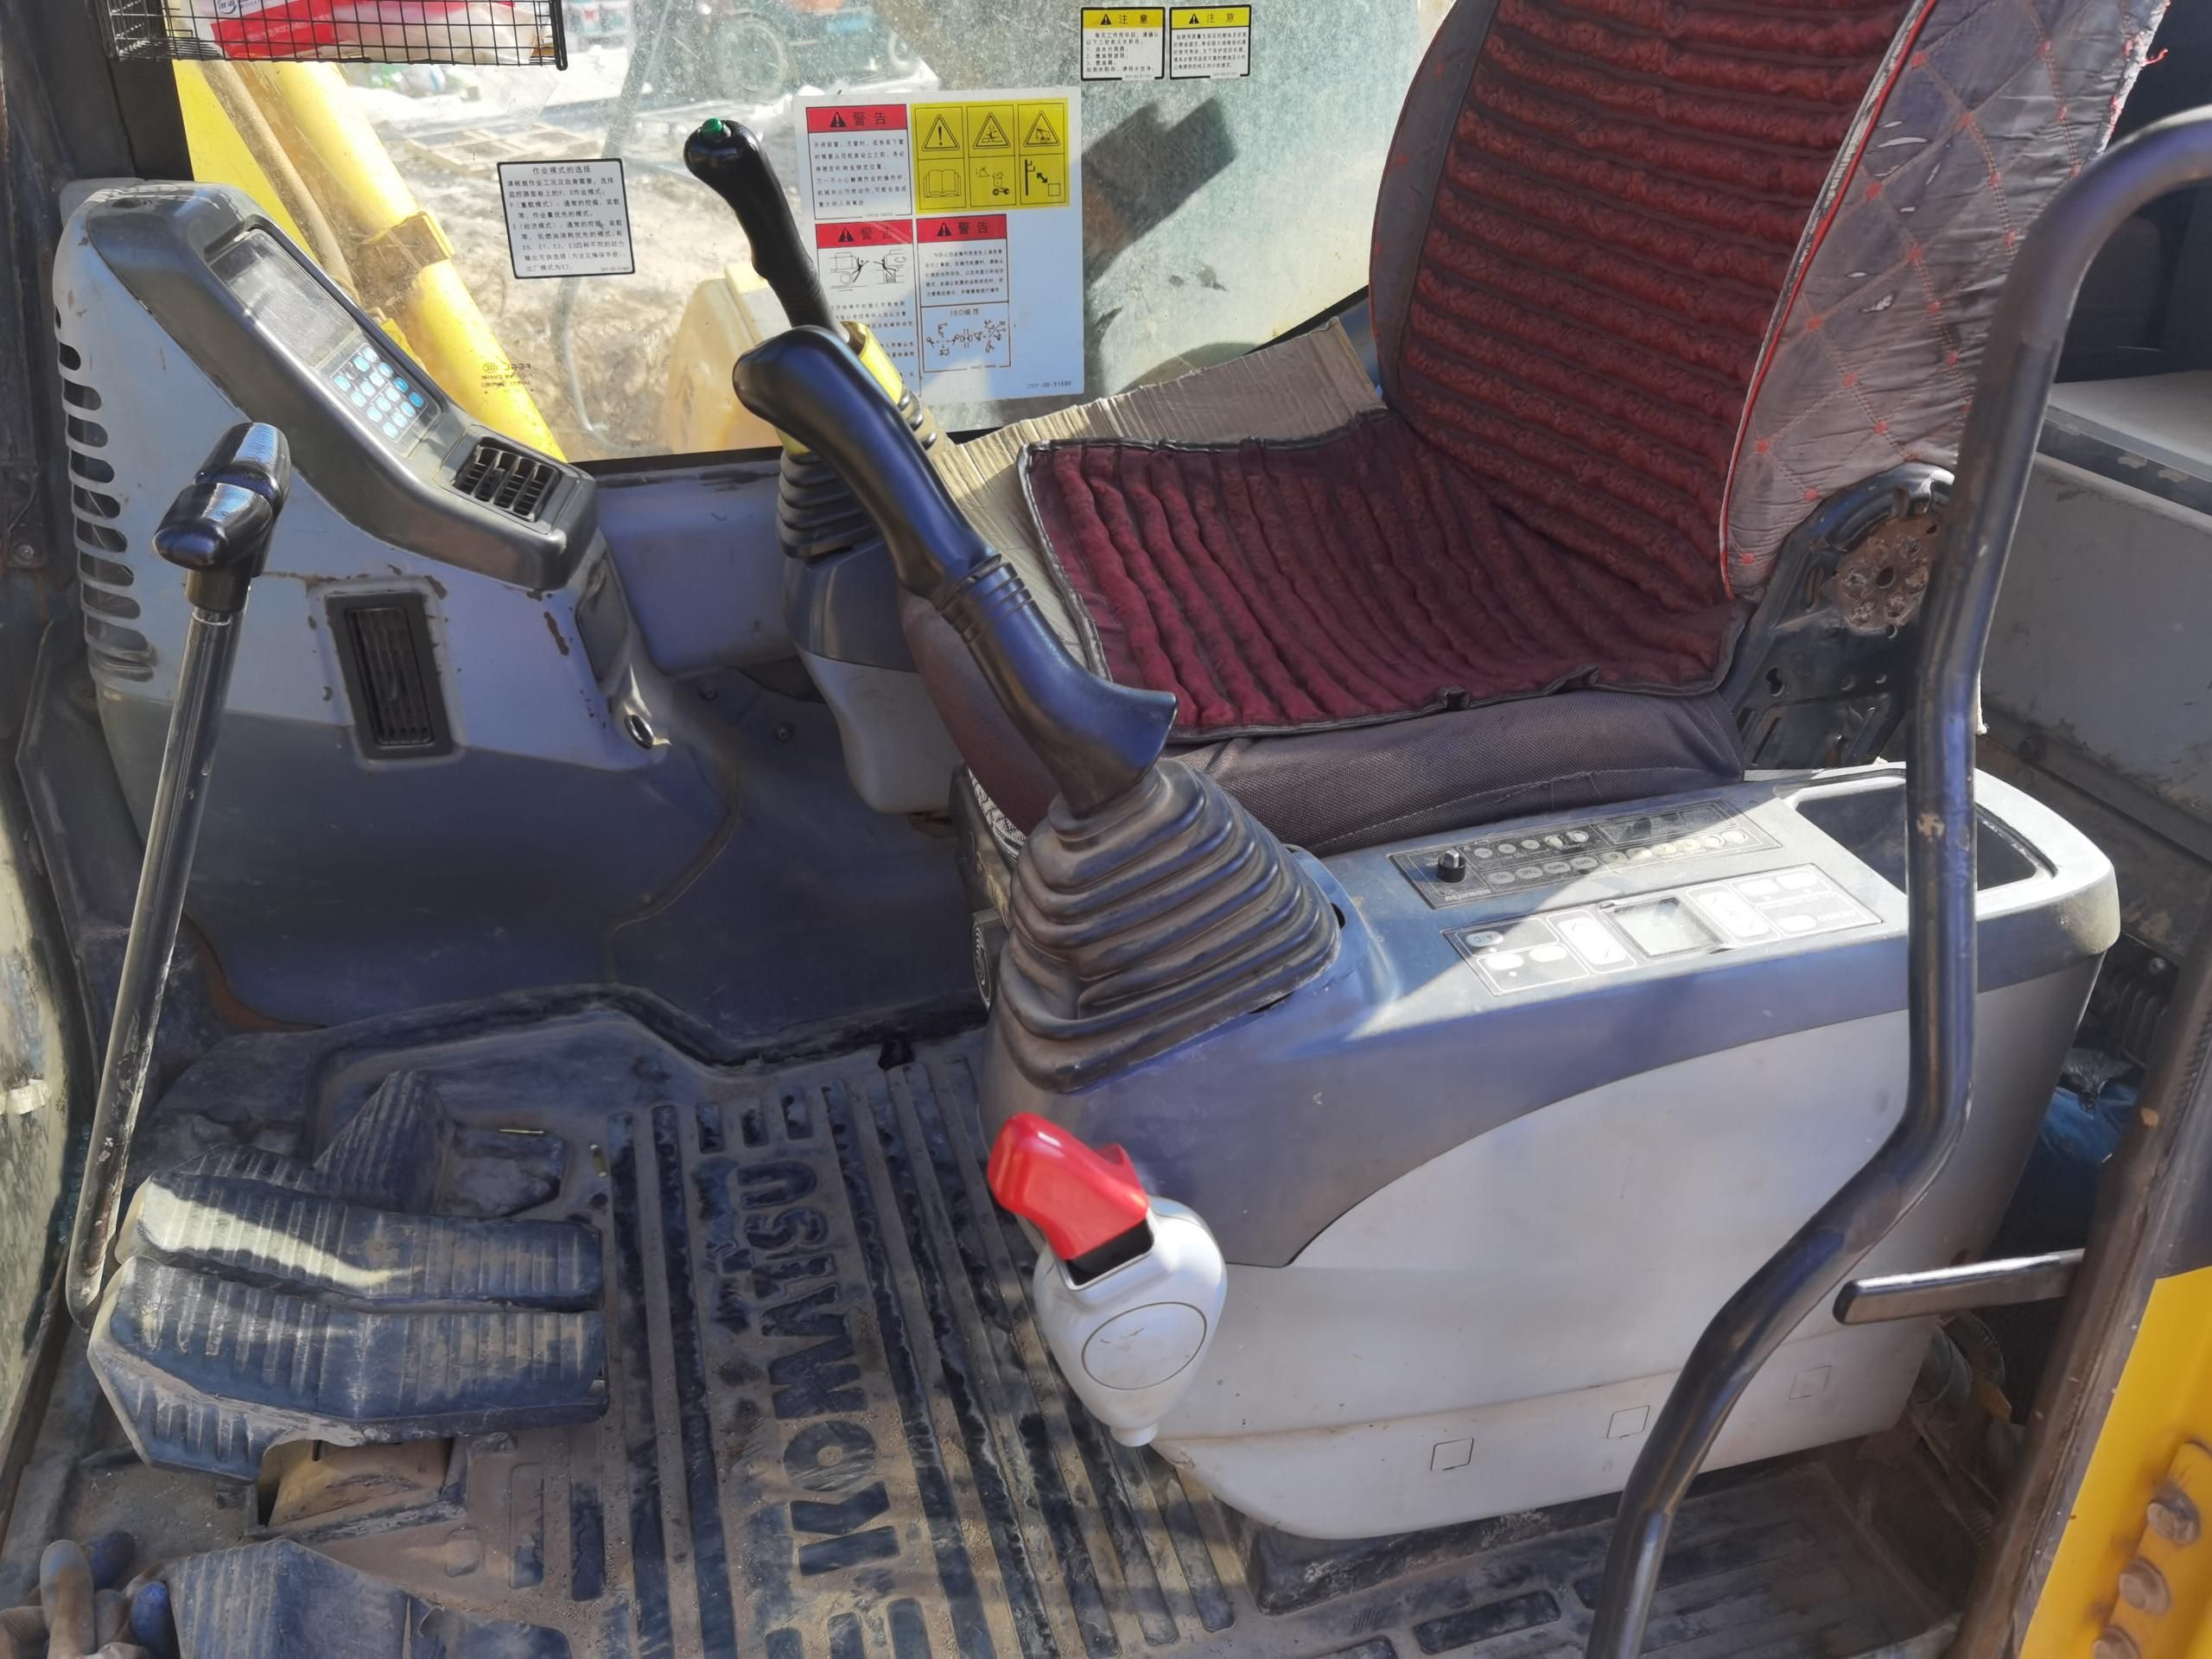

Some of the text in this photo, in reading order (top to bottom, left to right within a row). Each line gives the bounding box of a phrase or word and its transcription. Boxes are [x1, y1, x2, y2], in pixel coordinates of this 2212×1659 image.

[1119, 14, 1147, 24] 注意
[1206, 13, 1235, 23] 注意
[854, 111, 887, 126] 警告
[532, 166, 591, 175] 作业模式的选择
[861, 226, 893, 240] 警告
[958, 221, 988, 236] 警告
[737, 1160, 900, 1576] KOMATSU
